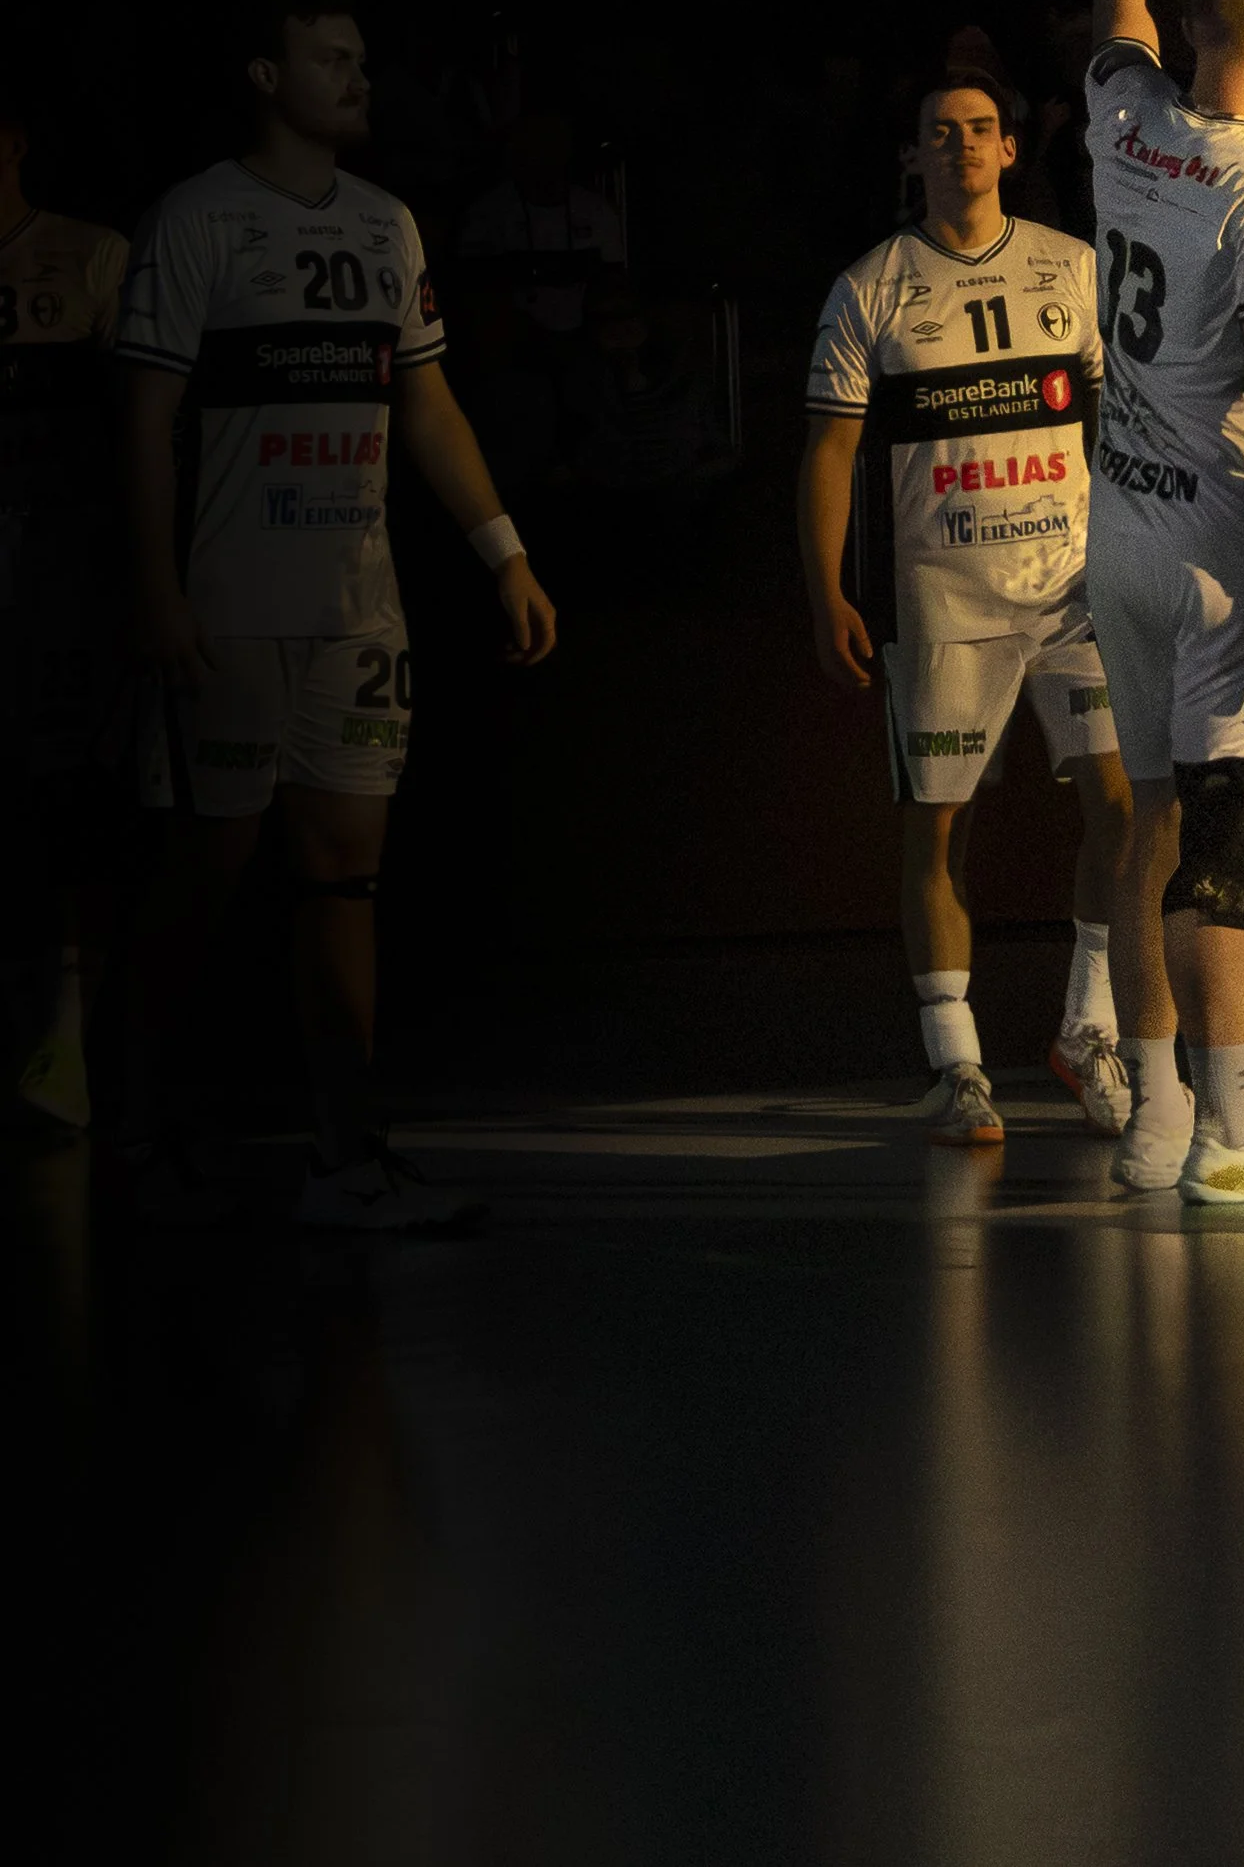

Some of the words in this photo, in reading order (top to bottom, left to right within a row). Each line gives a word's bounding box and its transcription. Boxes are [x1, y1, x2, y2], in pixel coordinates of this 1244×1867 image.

[295, 250, 368, 311] 20
[964, 295, 1012, 353] 11
[255, 340, 374, 370] SpareBank
[915, 373, 1039, 412] SpareBank
[258, 432, 383, 467] PELIAS
[933, 453, 1067, 494] PELIAS
[266, 488, 297, 524] YC
[943, 511, 973, 544] YC
[355, 649, 412, 710] 20
